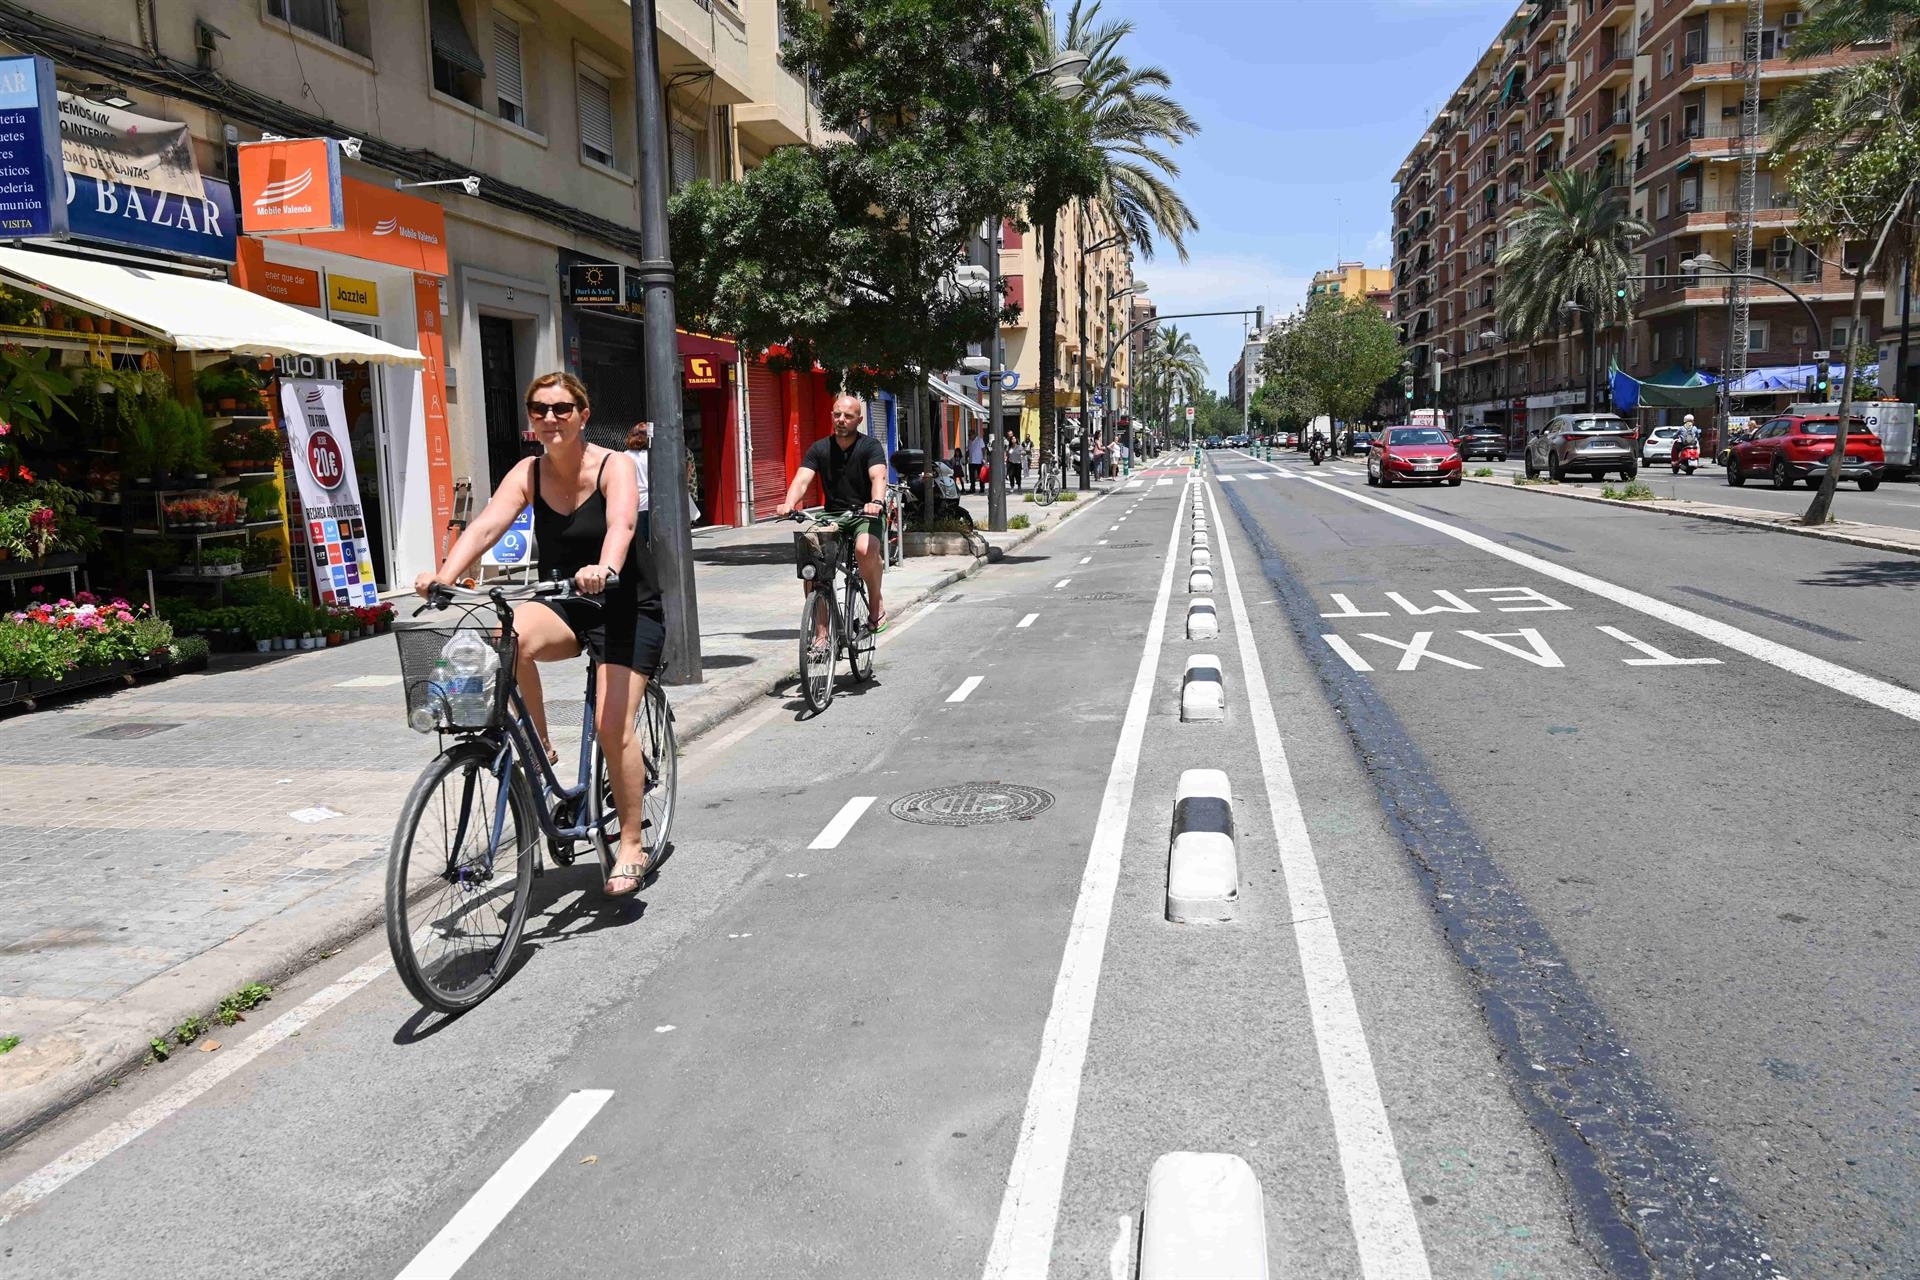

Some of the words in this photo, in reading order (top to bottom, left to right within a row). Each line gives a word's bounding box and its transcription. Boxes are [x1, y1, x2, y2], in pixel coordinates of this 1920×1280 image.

[93, 111, 110, 125] UN
[62, 151, 87, 166] DAD
[105, 161, 150, 180] PLANTAS
[96, 178, 224, 237] BAZAR
[257, 206, 281, 216] Mobile
[282, 204, 313, 214] Valencia
[2, 219, 33, 229] VISITA
[399, 225, 417, 240] Mobile
[417, 230, 438, 245] Valencia
[337, 286, 368, 305] Jazztel
[313, 447, 339, 478] 20€
[1320, 587, 1574, 617] EMT
[1320, 626, 1725, 671] TAXI
